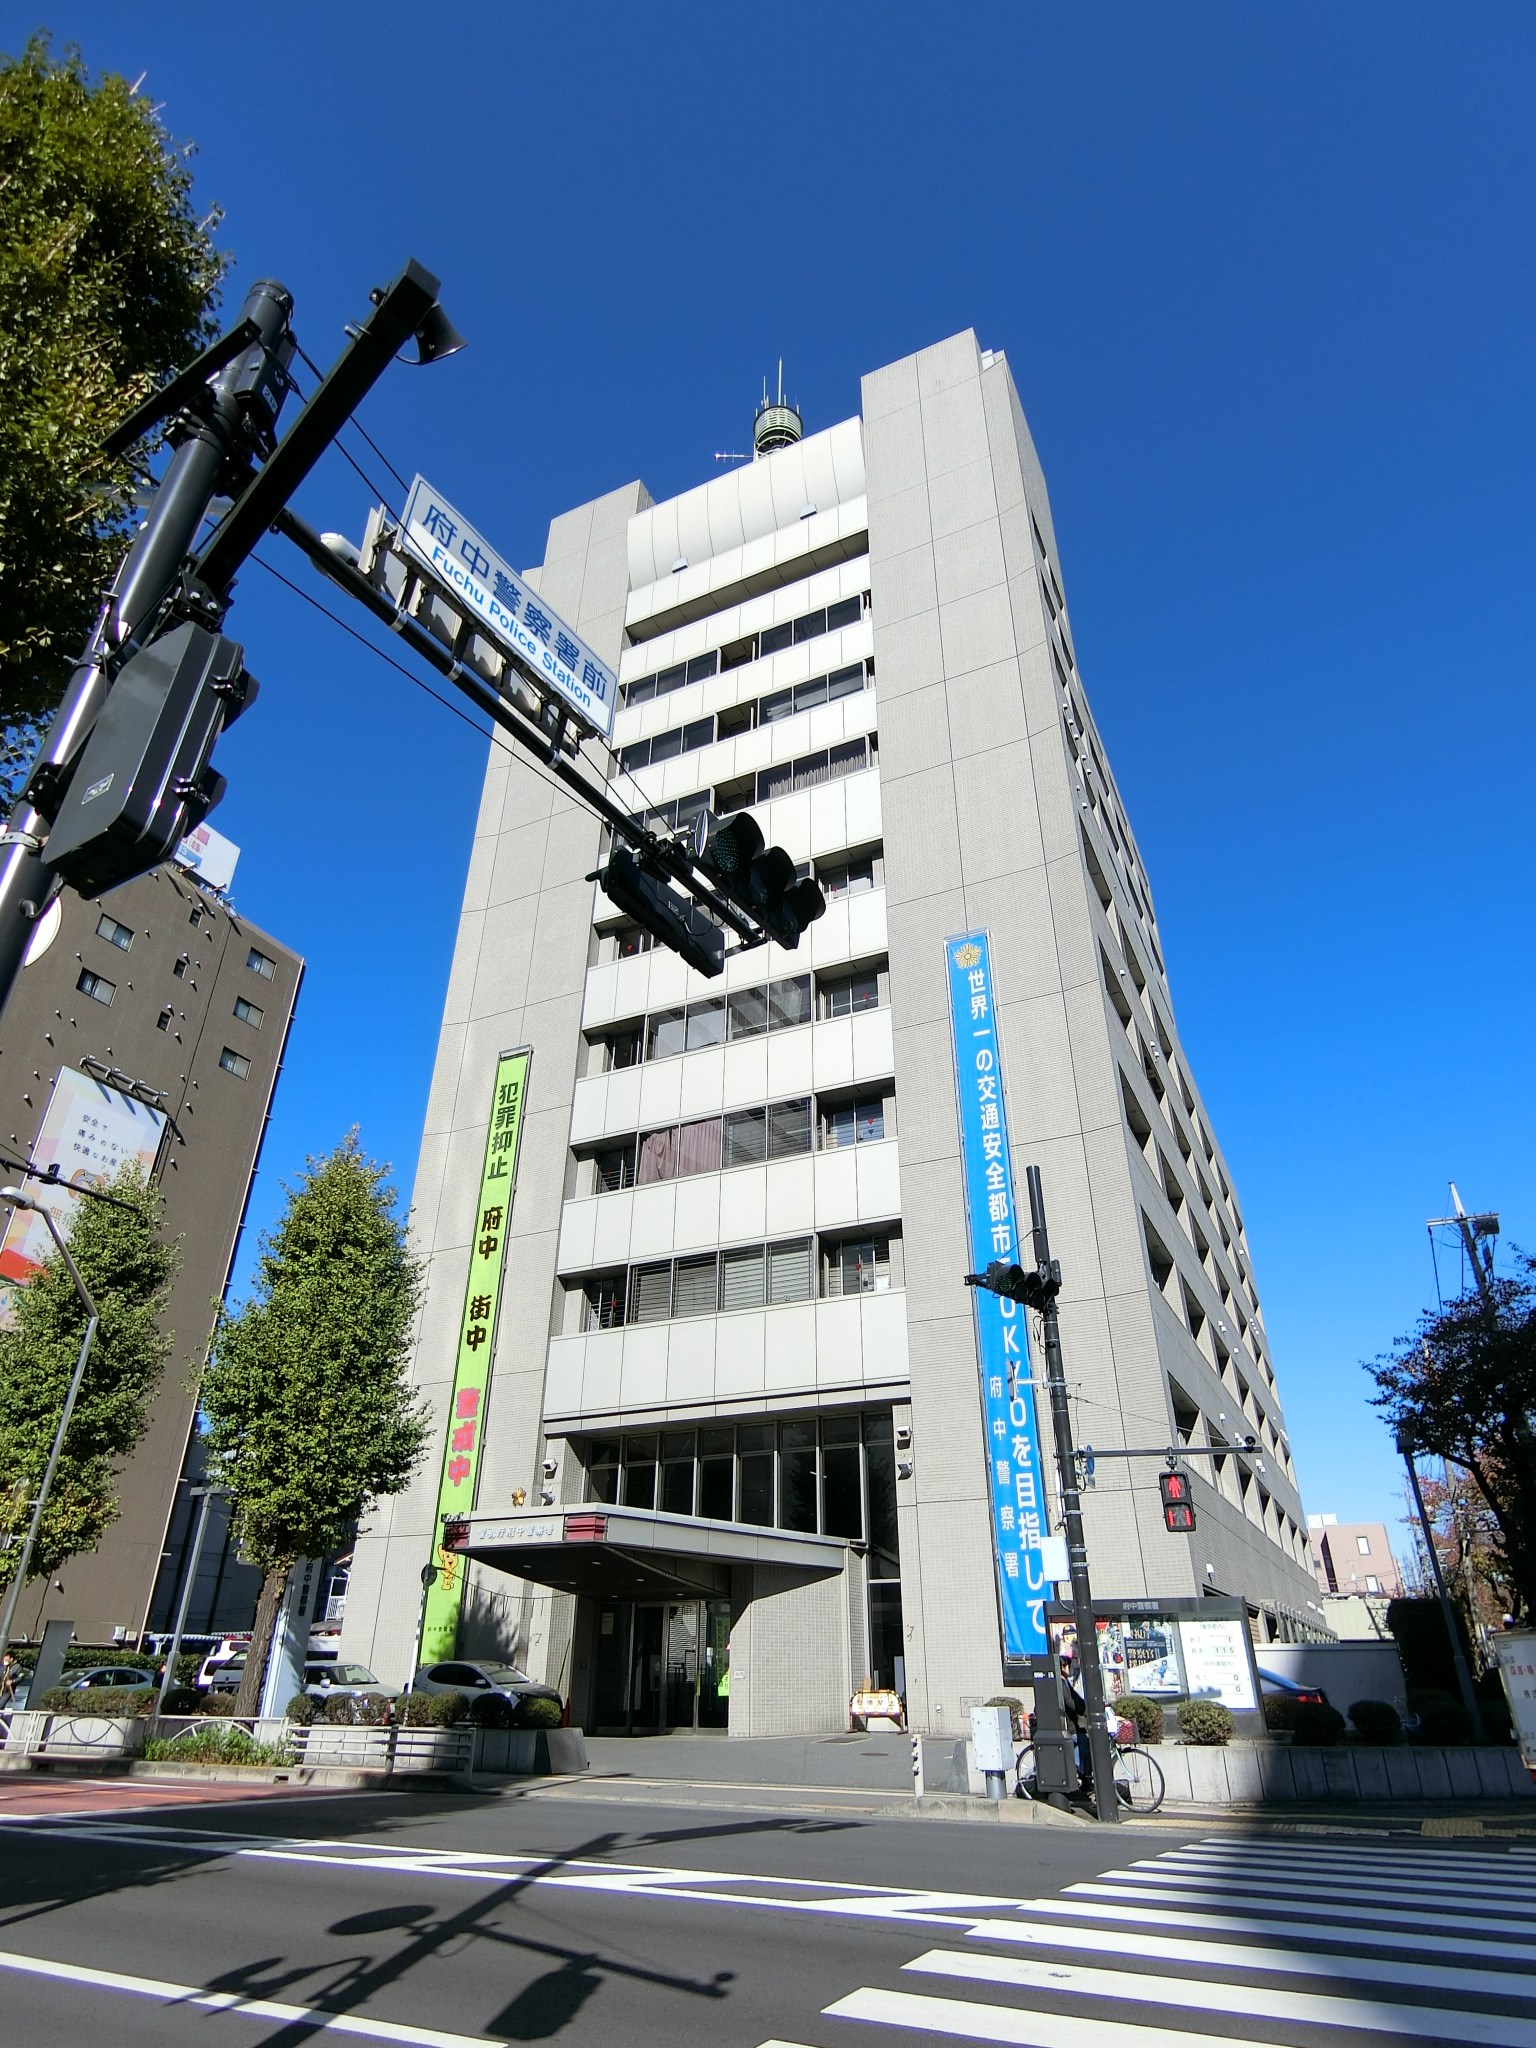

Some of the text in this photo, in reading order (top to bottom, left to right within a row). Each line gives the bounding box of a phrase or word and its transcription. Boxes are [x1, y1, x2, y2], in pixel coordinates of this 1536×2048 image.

[422, 504, 608, 700] 府中警察署前
[432, 545, 592, 709] Fuchu Police Station
[78, 1128, 129, 1155] 痛みのない
[81, 1114, 108, 1131] 安全で
[488, 1081, 519, 1180] 犯罪抑止
[73, 1142, 118, 1167] 快適なお産
[479, 1205, 504, 1261] 府中
[465, 1294, 492, 1352] 街中
[989, 1375, 1019, 1578] 府中警察署
